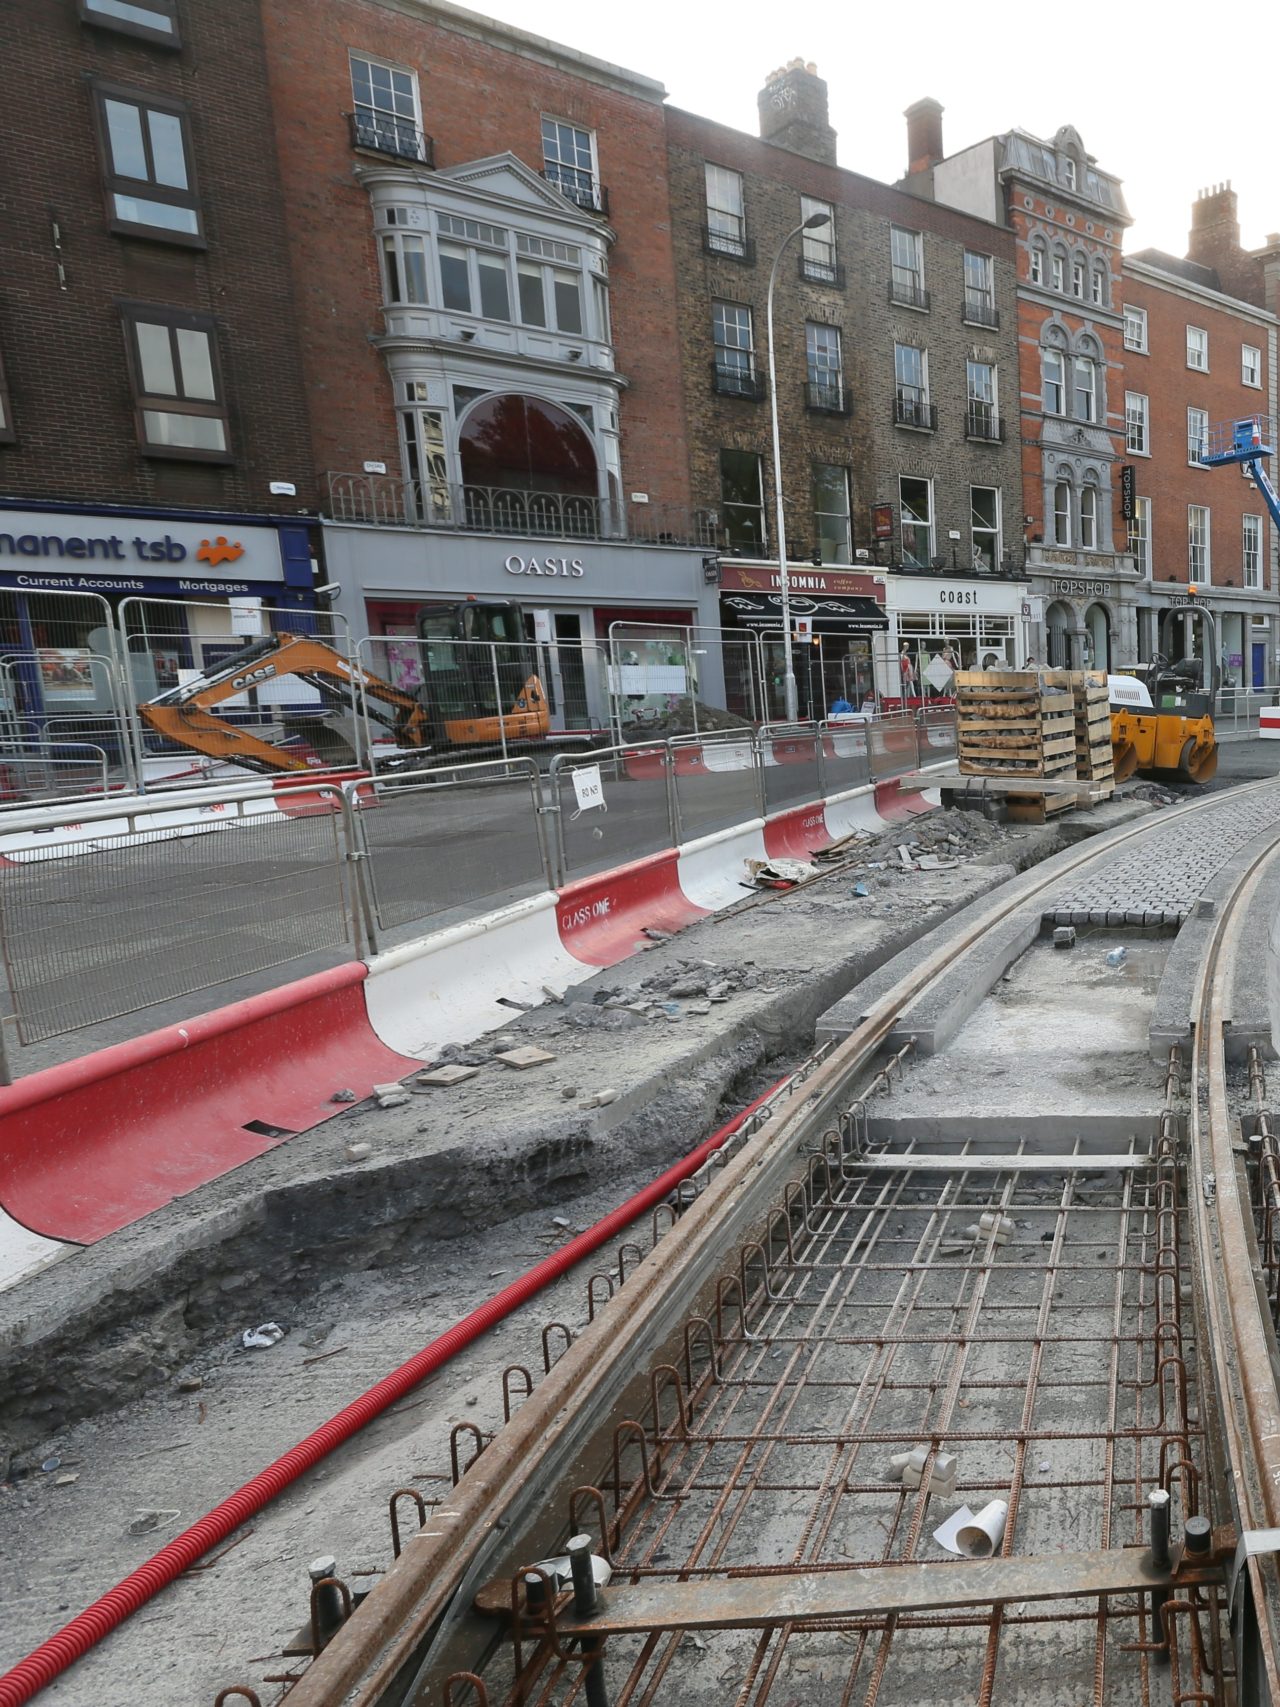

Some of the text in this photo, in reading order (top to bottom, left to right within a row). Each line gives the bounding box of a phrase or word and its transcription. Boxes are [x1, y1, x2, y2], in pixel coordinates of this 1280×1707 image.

[1123, 467, 1132, 518] TOPSHOP
[132, 535, 187, 561] tsb
[505, 555, 584, 577] OASIS
[17, 575, 144, 589] Current Accounts
[179, 581, 249, 592] Mortgages
[1052, 579, 1111, 596] TOPSHOP
[940, 590, 978, 605] coast
[233, 664, 275, 689] CASE
[562, 897, 611, 930] CLASS ONE
